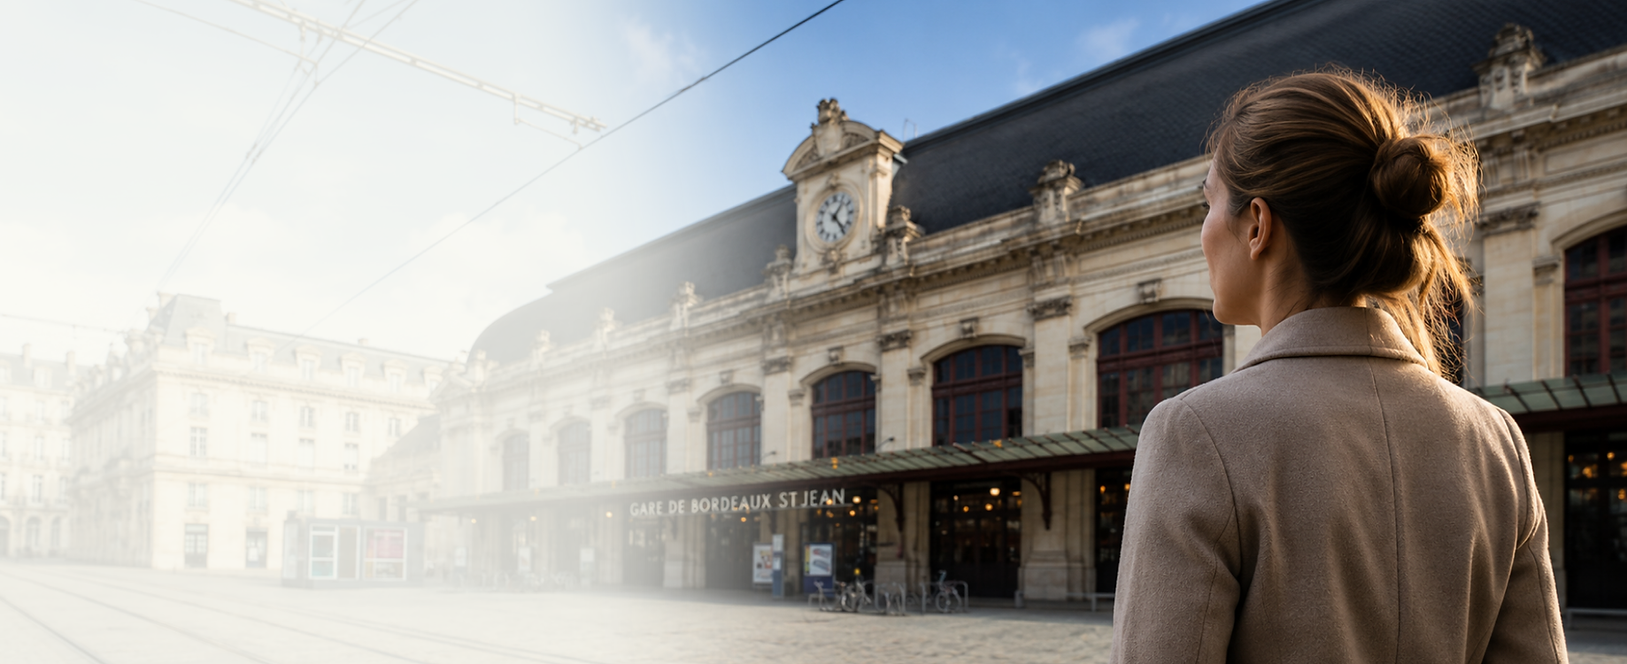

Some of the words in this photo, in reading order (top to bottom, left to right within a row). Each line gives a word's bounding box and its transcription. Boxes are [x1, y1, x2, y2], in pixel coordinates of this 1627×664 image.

[630, 501, 663, 517] GARE
[668, 499, 685, 514] DE
[691, 493, 771, 513] BORDEAUX
[779, 491, 798, 508] ST
[801, 488, 845, 507] JEAN
